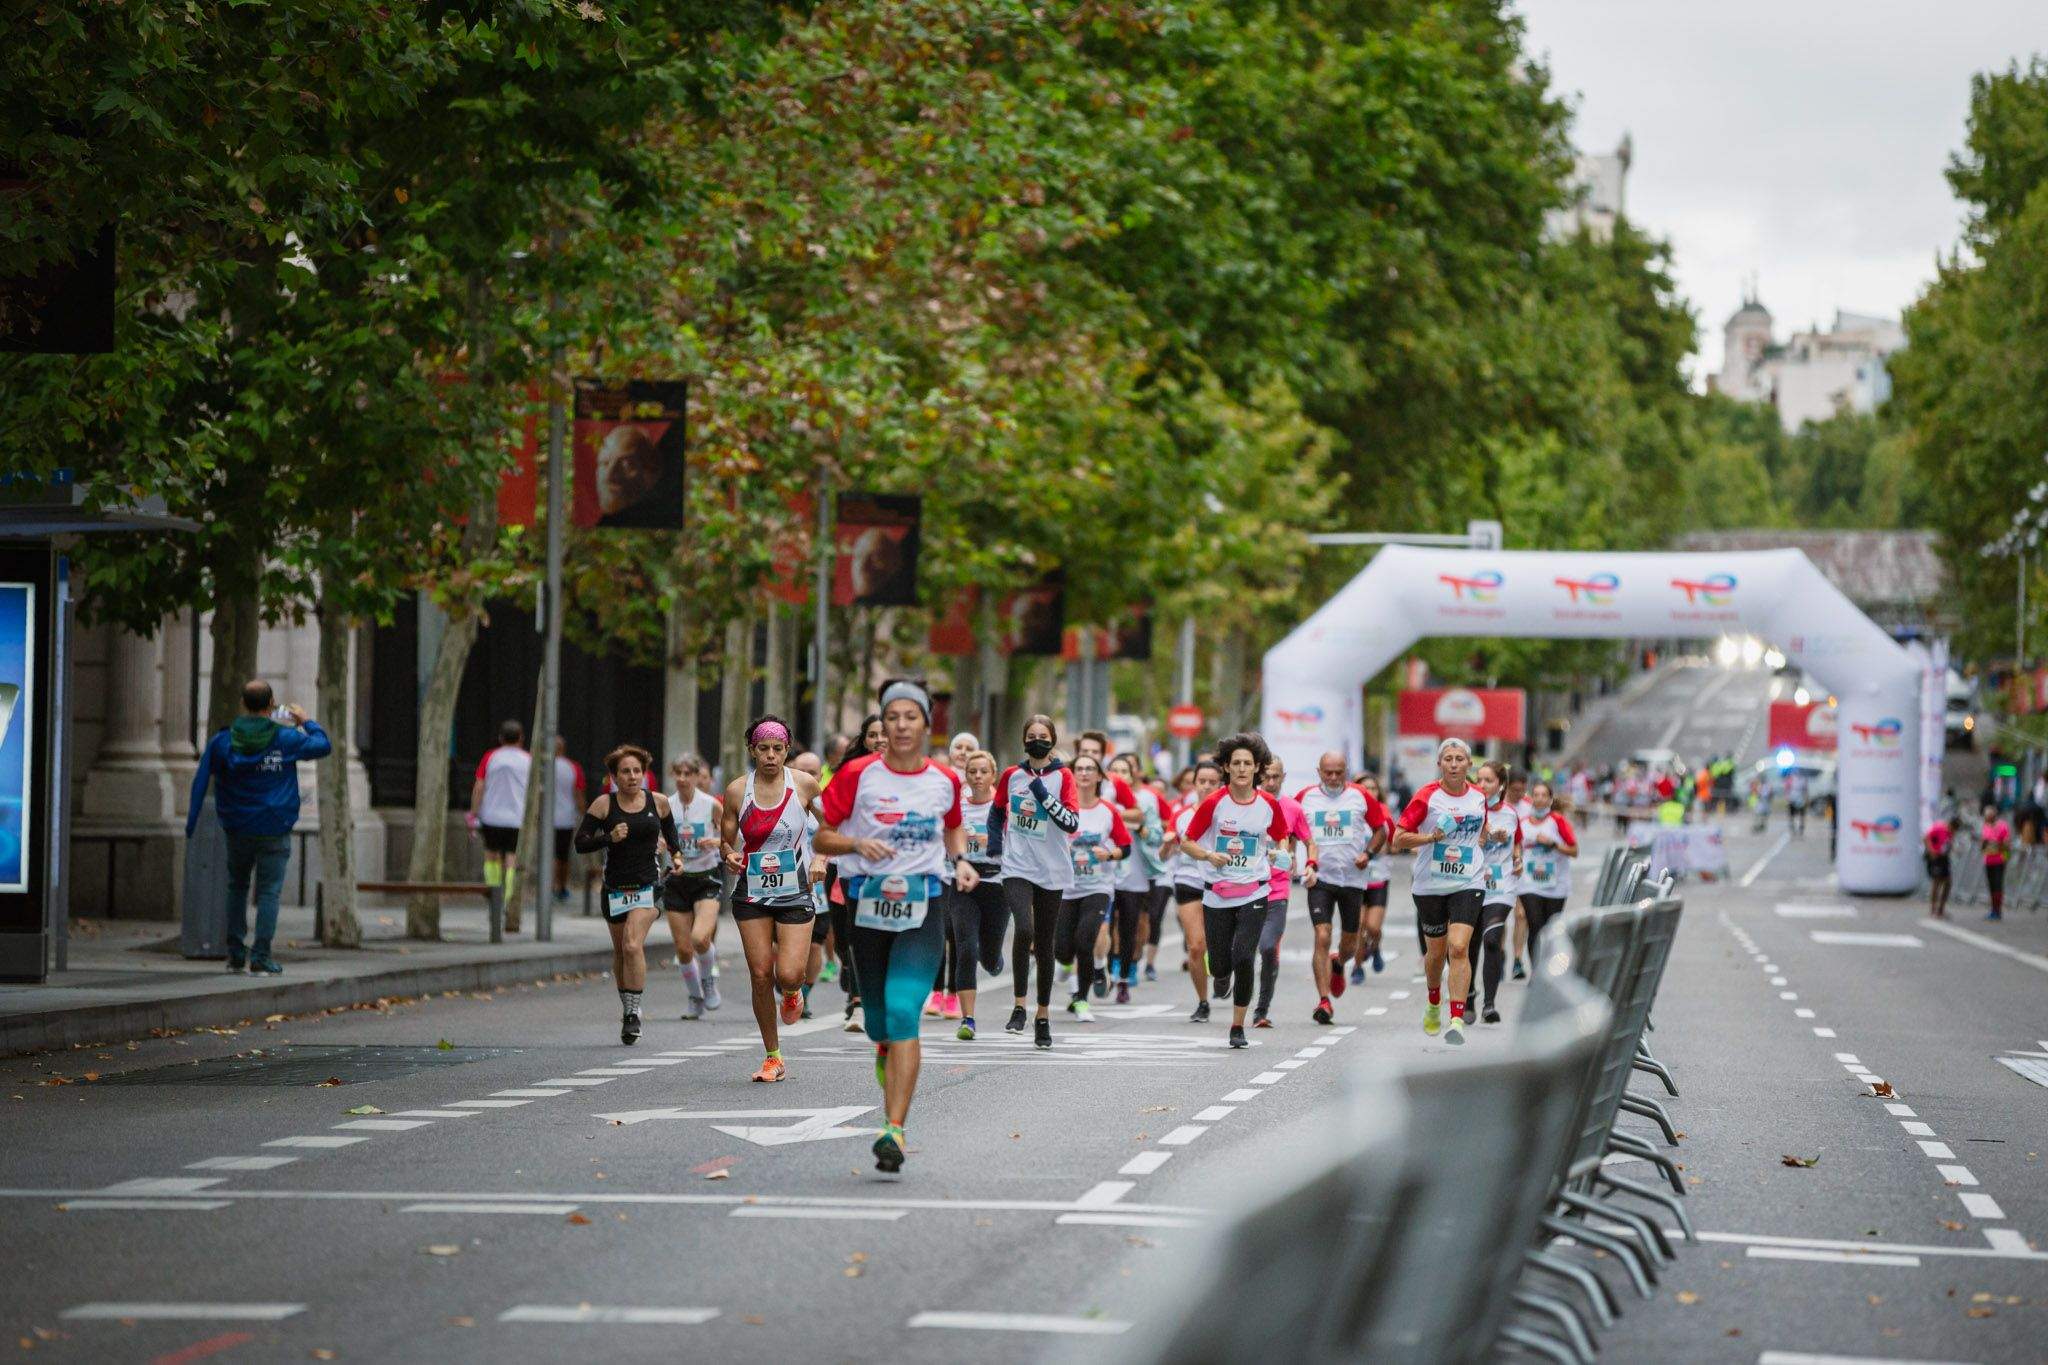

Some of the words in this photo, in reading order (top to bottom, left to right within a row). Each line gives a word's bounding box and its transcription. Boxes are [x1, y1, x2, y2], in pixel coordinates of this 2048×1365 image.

[1016, 815, 1038, 831] 1047
[1323, 827, 1344, 837] 1075
[1440, 862, 1465, 874] 1062
[761, 874, 784, 888] 297
[873, 900, 913, 919] 1064
